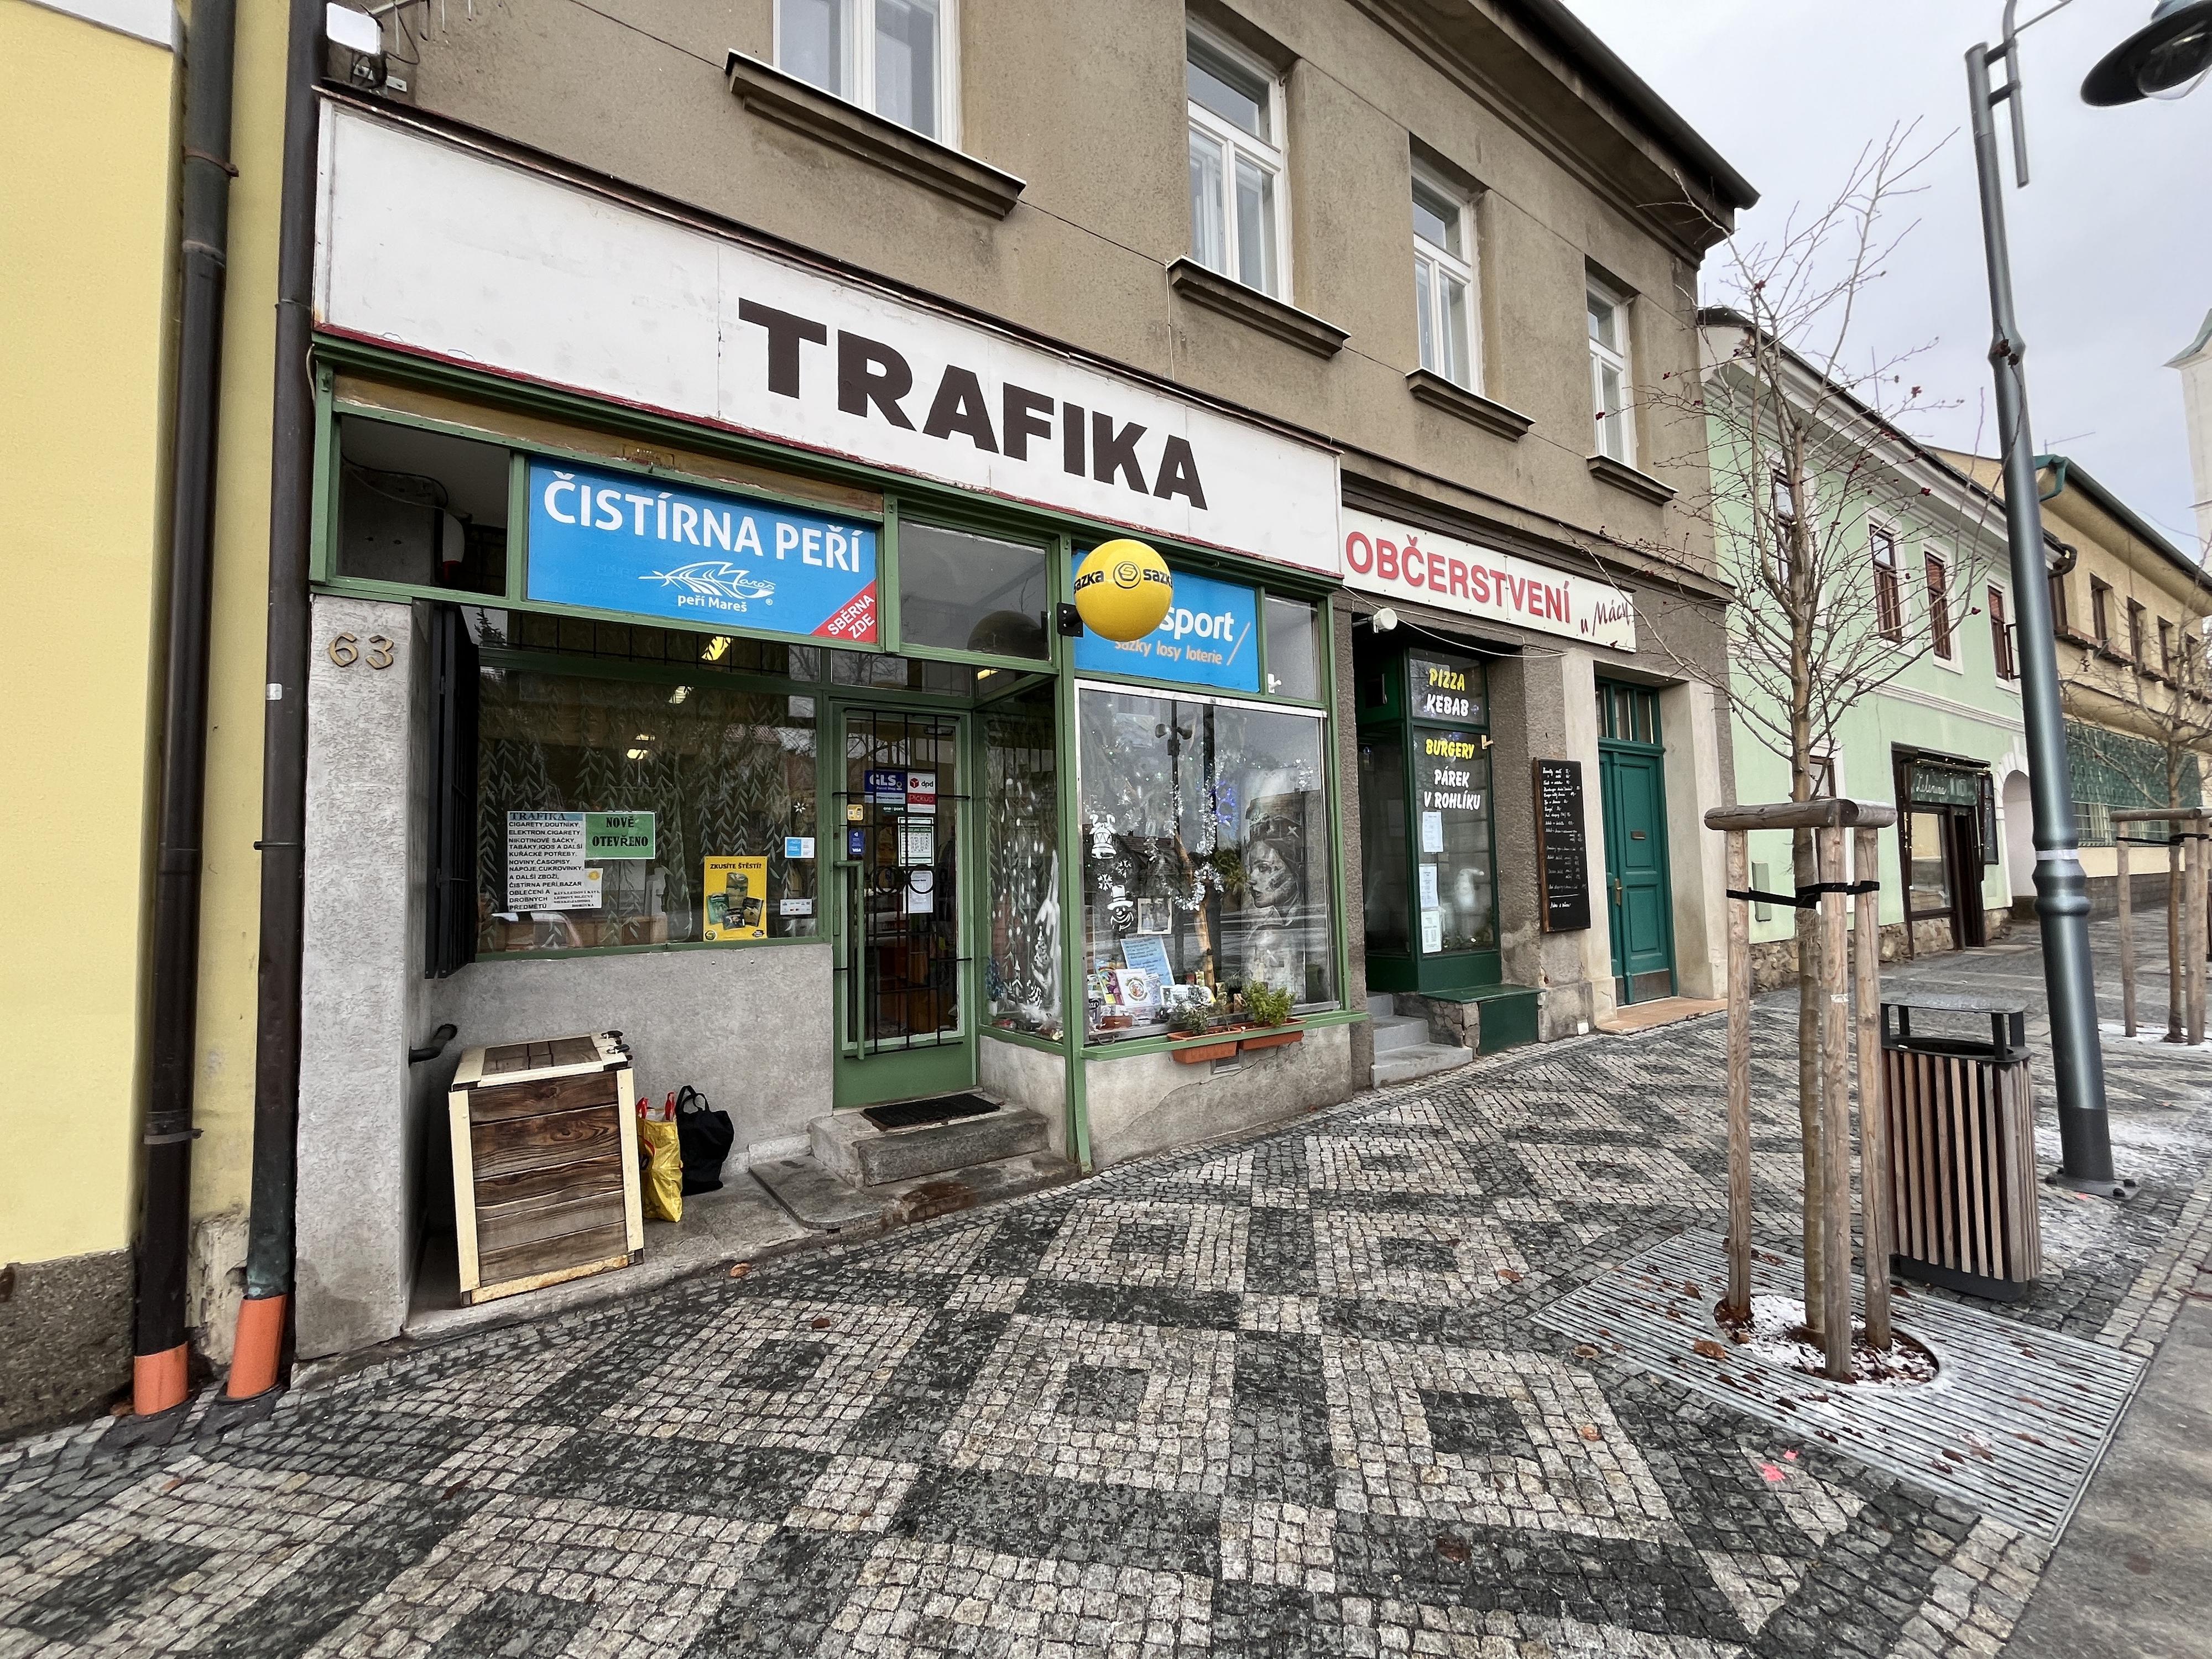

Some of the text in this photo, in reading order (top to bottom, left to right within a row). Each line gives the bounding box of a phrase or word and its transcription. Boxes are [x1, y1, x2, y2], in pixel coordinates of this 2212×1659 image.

[739, 297, 1207, 510] TRAFIKA
[544, 471, 863, 573] ČISTÍRNA PEŘÍ
[1345, 531, 1570, 624] OBČERSTVENÍ
[1581, 618, 1588, 634] u
[678, 594, 747, 612] peří Mareš
[827, 594, 875, 635] SBĚRNA
[848, 613, 875, 639] ZDE
[329, 632, 394, 670] 63
[1156, 640, 1181, 661] losy
[1186, 645, 1222, 665] loterie
[1429, 667, 1465, 691] PIZZA
[1426, 693, 1469, 717] KEBAB
[1425, 739, 1475, 759] BURGERY
[1434, 766, 1470, 788] PÁREK
[909, 794, 933, 802] Pickup
[1424, 790, 1480, 811] V ROHLÍKU
[510, 812, 566, 821] TRAFIKA
[592, 834, 649, 847] OTEVŘENO
